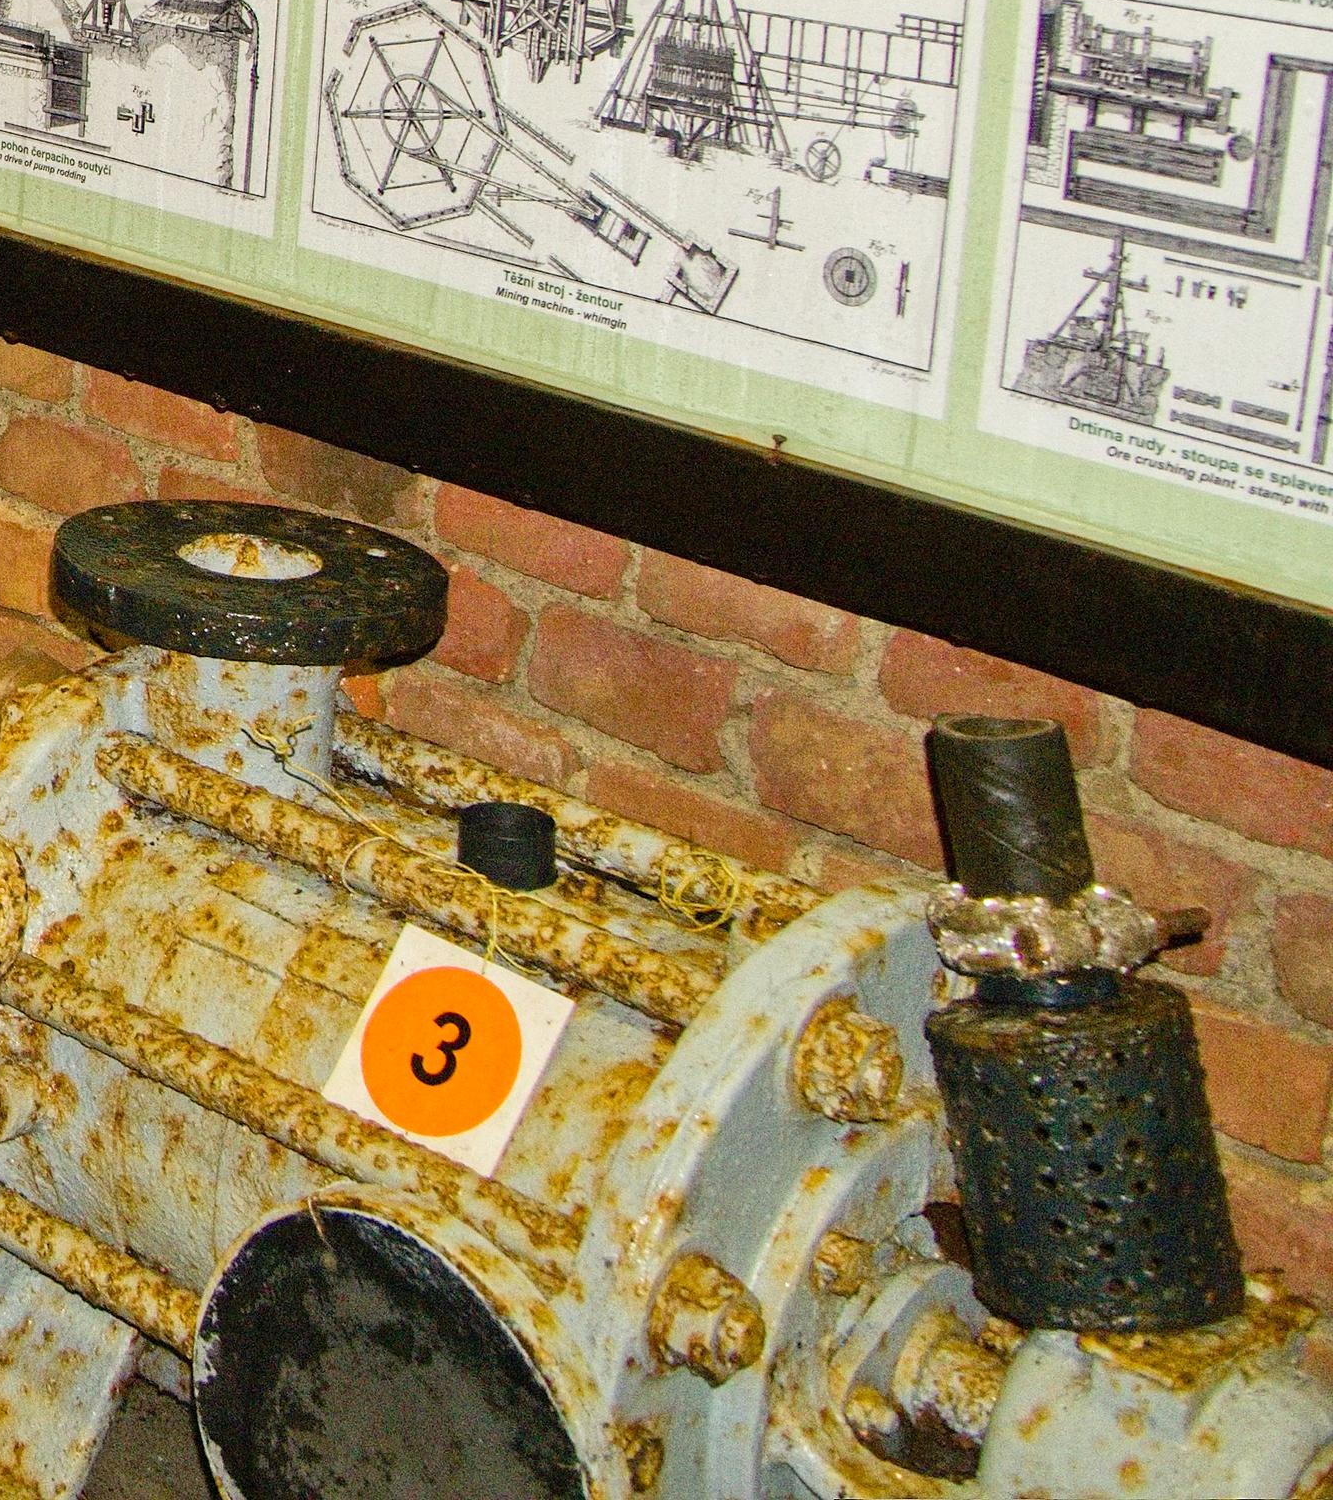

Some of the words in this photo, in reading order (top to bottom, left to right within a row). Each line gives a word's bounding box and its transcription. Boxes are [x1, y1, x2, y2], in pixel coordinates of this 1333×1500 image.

[1, 140, 29, 155] pohon
[4, 153, 23, 165] drive
[24, 159, 33, 167] of
[33, 162, 56, 175] pump
[57, 167, 87, 184] rodding
[495, 286, 530, 306] Mining
[531, 296, 574, 316] machine
[583, 311, 627, 330] whimgin
[538, 281, 566, 300] stroj
[575, 289, 624, 312] žentour
[1128, 435, 1166, 456] rudy
[1181, 449, 1240, 474] stoupa
[1244, 465, 1265, 479] se
[1106, 445, 1132, 462] Ore
[1134, 454, 1195, 482] crushing
[1199, 471, 1237, 489] plant
[1248, 484, 1294, 506] stamp
[1298, 498, 1329, 514] with
[410, 1011, 472, 1087] 3
